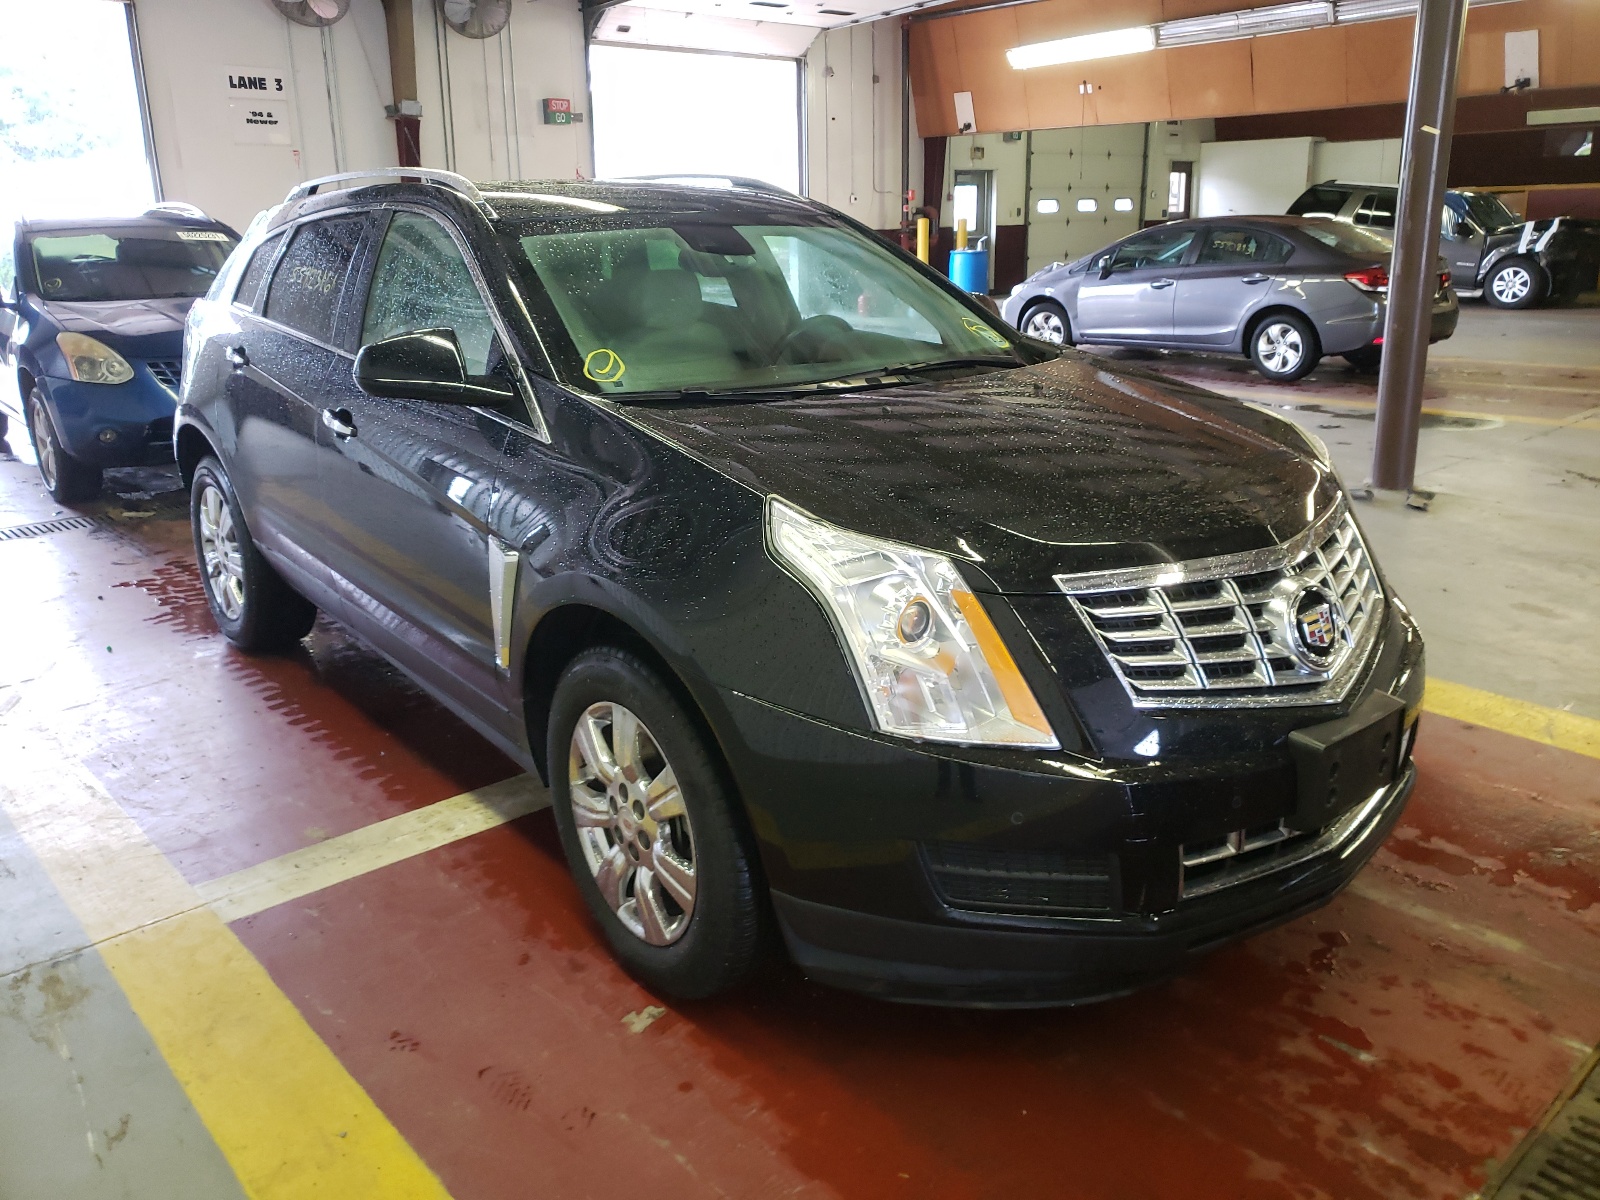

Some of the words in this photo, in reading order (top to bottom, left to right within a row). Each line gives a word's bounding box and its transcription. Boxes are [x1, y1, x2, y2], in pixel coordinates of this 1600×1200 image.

[229, 75, 267, 90] LANE
[274, 78, 283, 91] 3
[552, 100, 568, 110] STOP
[555, 112, 566, 122] GO
